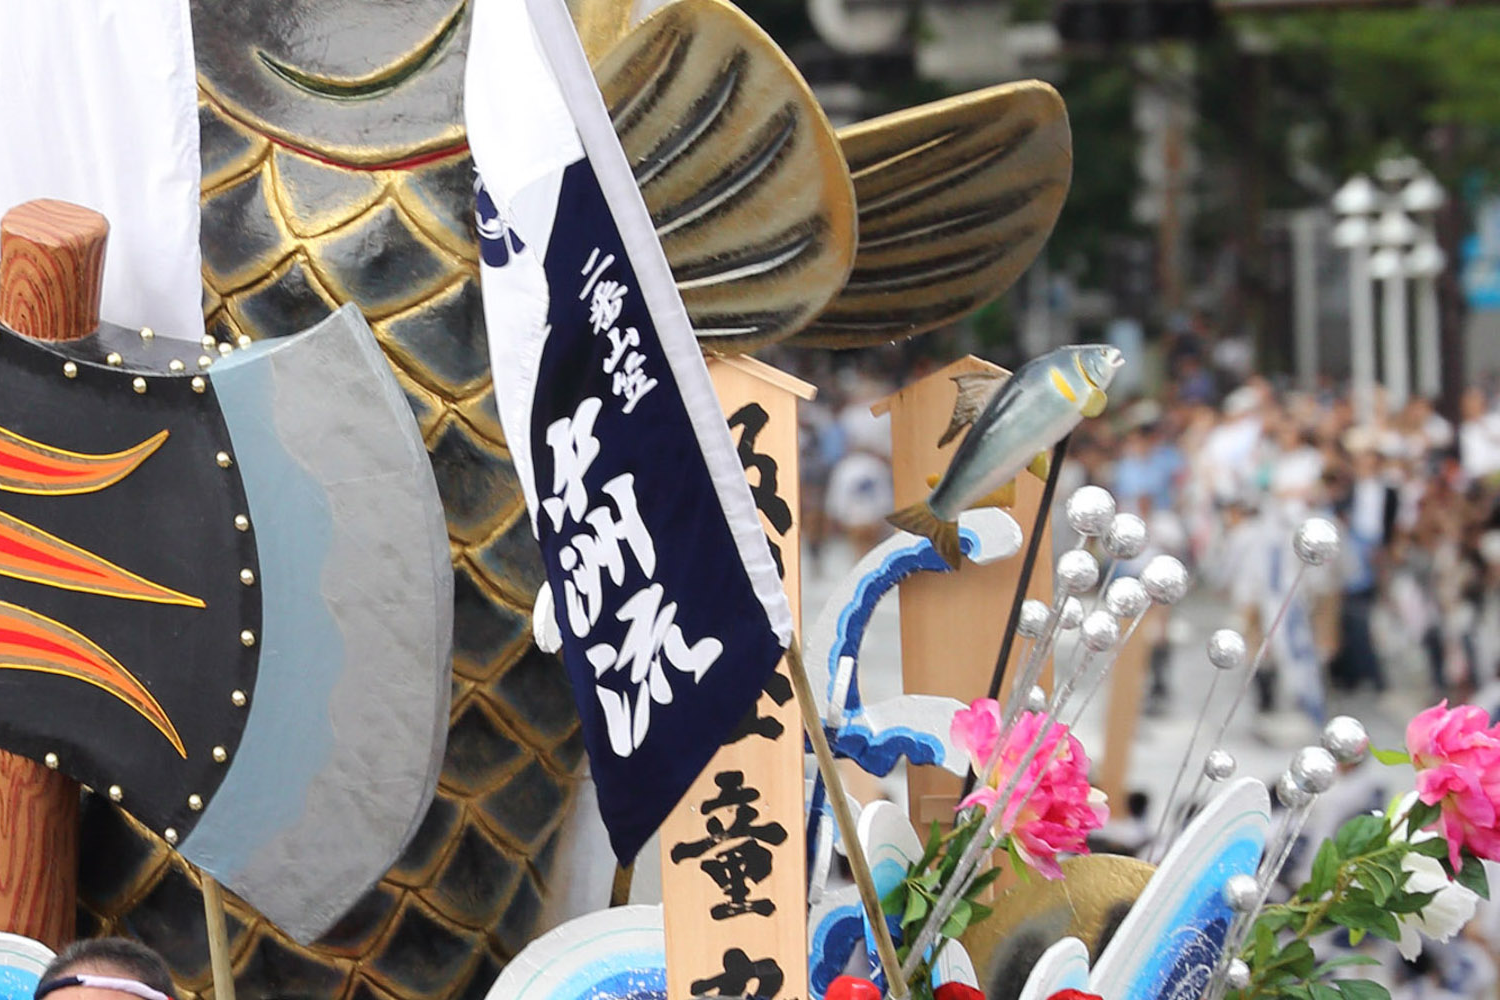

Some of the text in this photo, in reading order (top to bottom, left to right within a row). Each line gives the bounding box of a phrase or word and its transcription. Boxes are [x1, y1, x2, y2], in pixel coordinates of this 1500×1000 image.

[579, 247, 658, 414] 二番山笠
[542, 397, 723, 758] 中洲流
